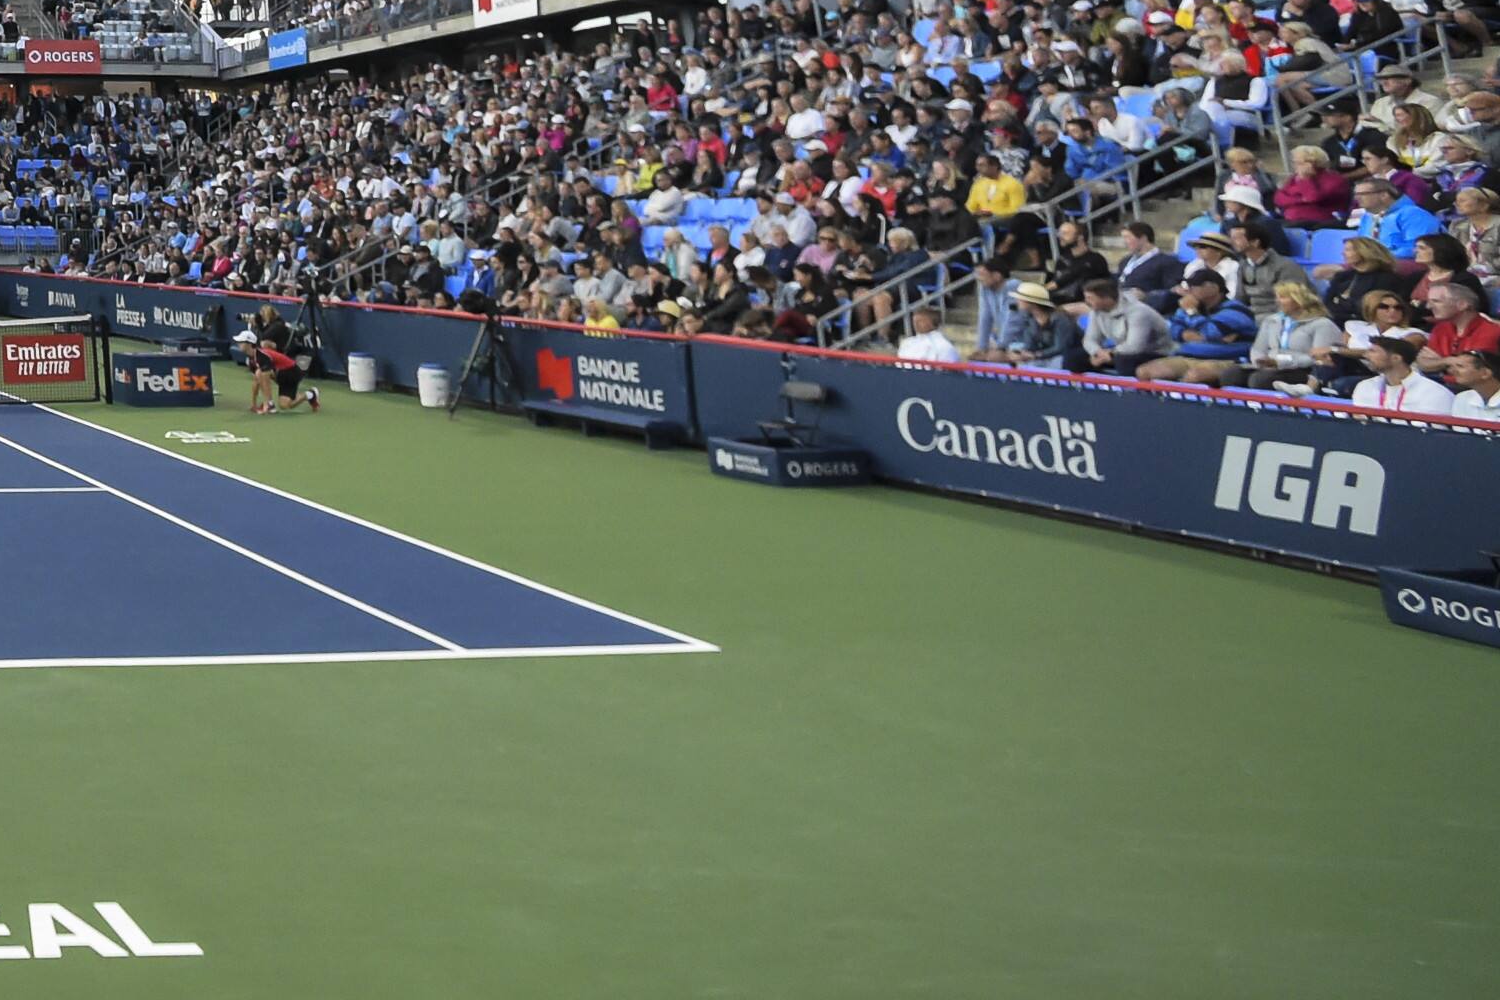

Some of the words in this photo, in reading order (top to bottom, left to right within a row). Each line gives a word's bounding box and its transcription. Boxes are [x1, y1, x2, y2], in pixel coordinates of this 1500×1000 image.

[44, 51, 95, 63] ROGERS
[55, 292, 76, 308] AVIVA
[116, 293, 126, 309] LA
[163, 307, 204, 330] CAMBRIA
[6, 344, 81, 361] Emirates
[18, 361, 34, 376] FLY
[36, 361, 70, 376] BETTER
[577, 355, 640, 383] BANQUE
[137, 367, 210, 392] FedEx
[580, 380, 665, 412] NATIONALE
[896, 396, 1104, 482] Canada
[803, 461, 859, 477] ROGERS
[1214, 435, 1386, 537] IGA
